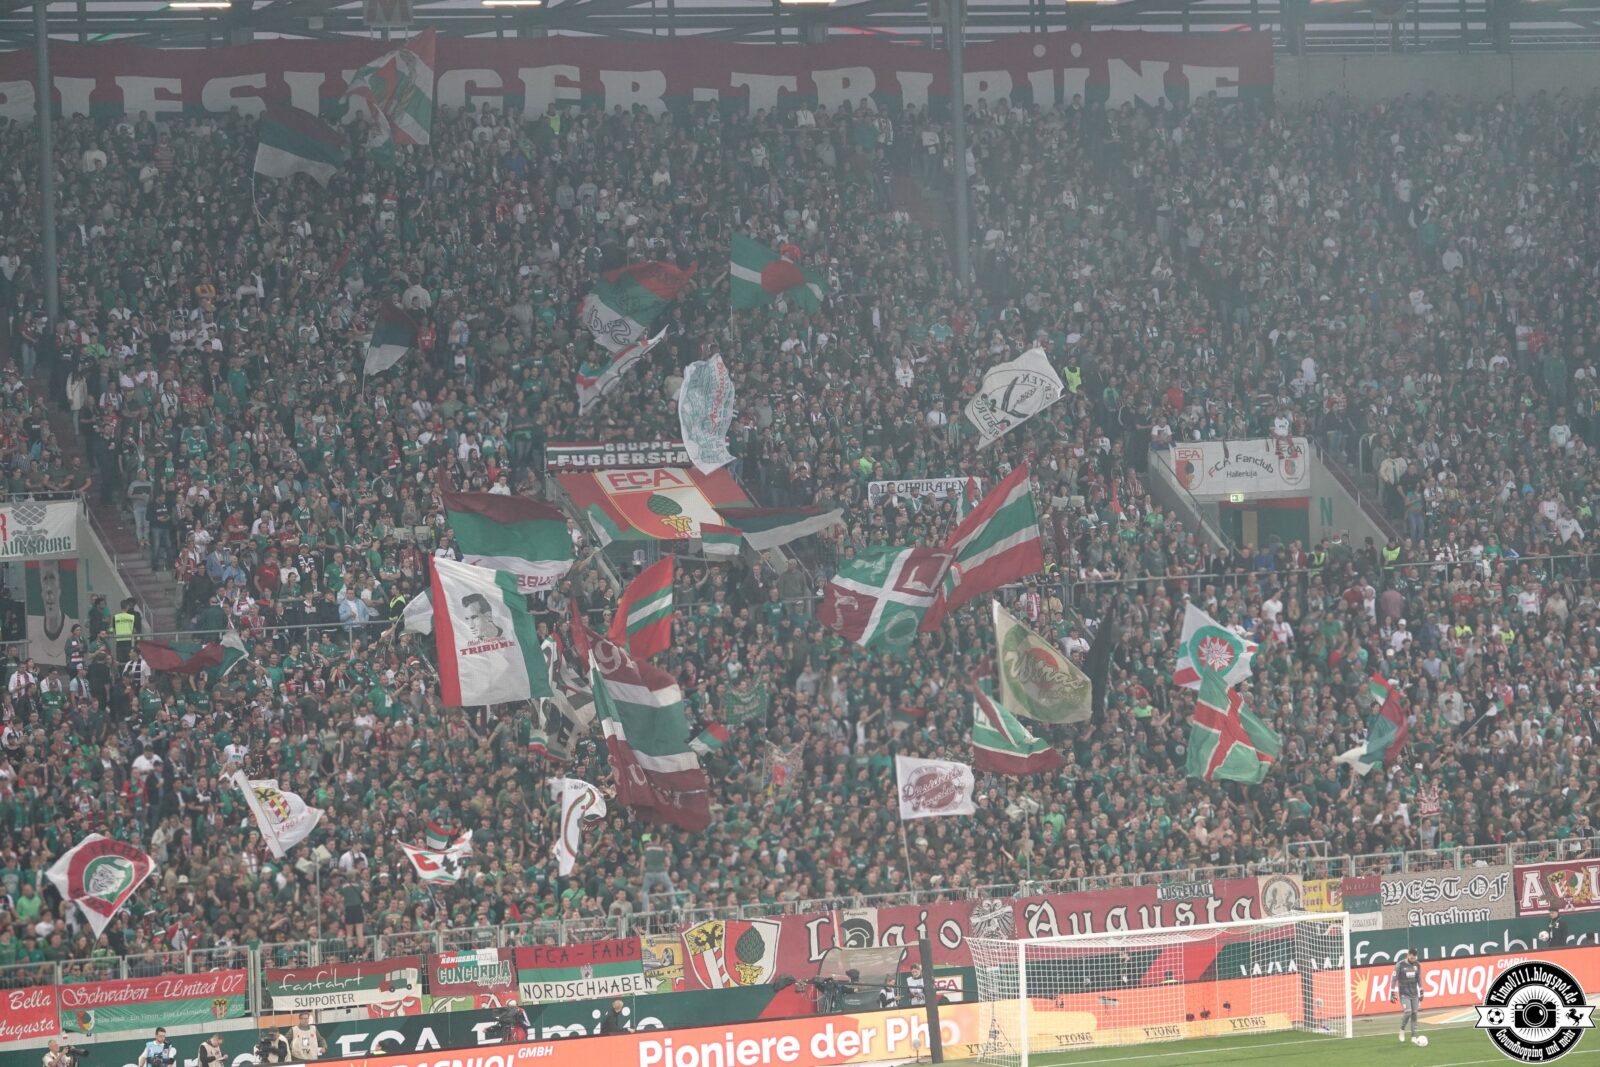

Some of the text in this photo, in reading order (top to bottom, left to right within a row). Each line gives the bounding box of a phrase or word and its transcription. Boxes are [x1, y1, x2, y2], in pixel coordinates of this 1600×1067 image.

[0, 43, 1240, 122] IESIGER-TRIBÜNE
[605, 441, 672, 453] GRUPPE
[1178, 450, 1201, 459] FCA
[557, 451, 691, 467] FUGGERSTA
[1208, 454, 1275, 478] FCA Fanclub
[606, 468, 685, 488] FCA
[880, 479, 967, 495] LCHPIRATEN
[805, 896, 1259, 963] Lgio Augusta
[533, 947, 567, 966] FCA
[591, 940, 637, 961] FANS
[61, 973, 244, 1007] Schwaben United 07
[522, 974, 653, 999] NORDSCHWABEN
[1370, 965, 1496, 1003] KSNIQI
[8, 989, 52, 1010] Bella
[294, 993, 355, 1008] SUPPORTER
[1143, 1024, 1181, 1038] YTONG
[1228, 1016, 1267, 1029] YTONG
[638, 1031, 801, 1067] Pioniere
[810, 1022, 877, 1060] der
[1055, 1032, 1094, 1046] YTONG
[517, 1045, 554, 1058] GMBH
